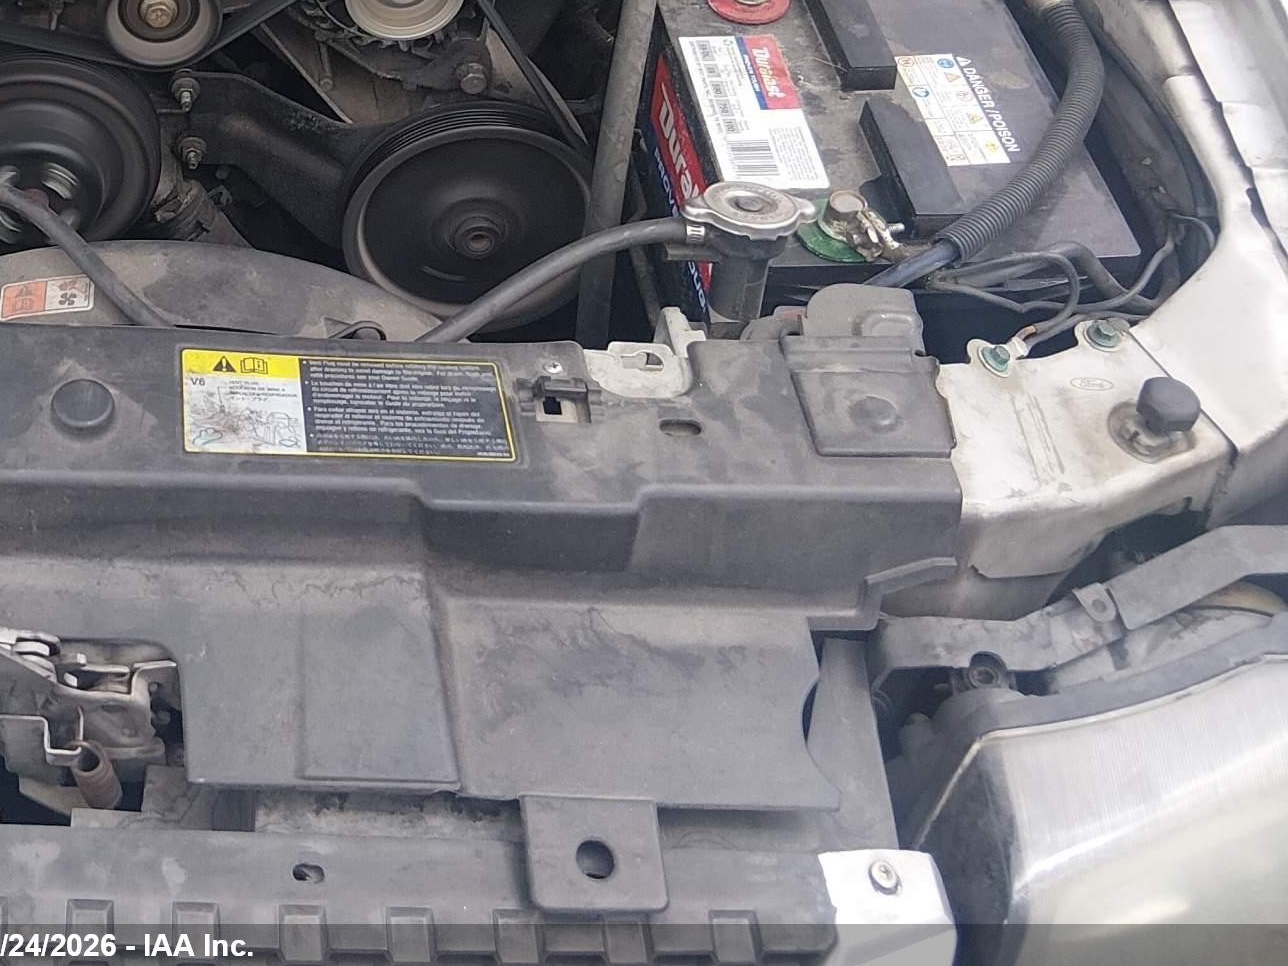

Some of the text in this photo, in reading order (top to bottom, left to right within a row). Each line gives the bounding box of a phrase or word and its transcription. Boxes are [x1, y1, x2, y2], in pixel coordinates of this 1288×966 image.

[752, 46, 786, 98] Duralast
[991, 113, 1020, 152] POISON
[190, 378, 206, 386] V6
